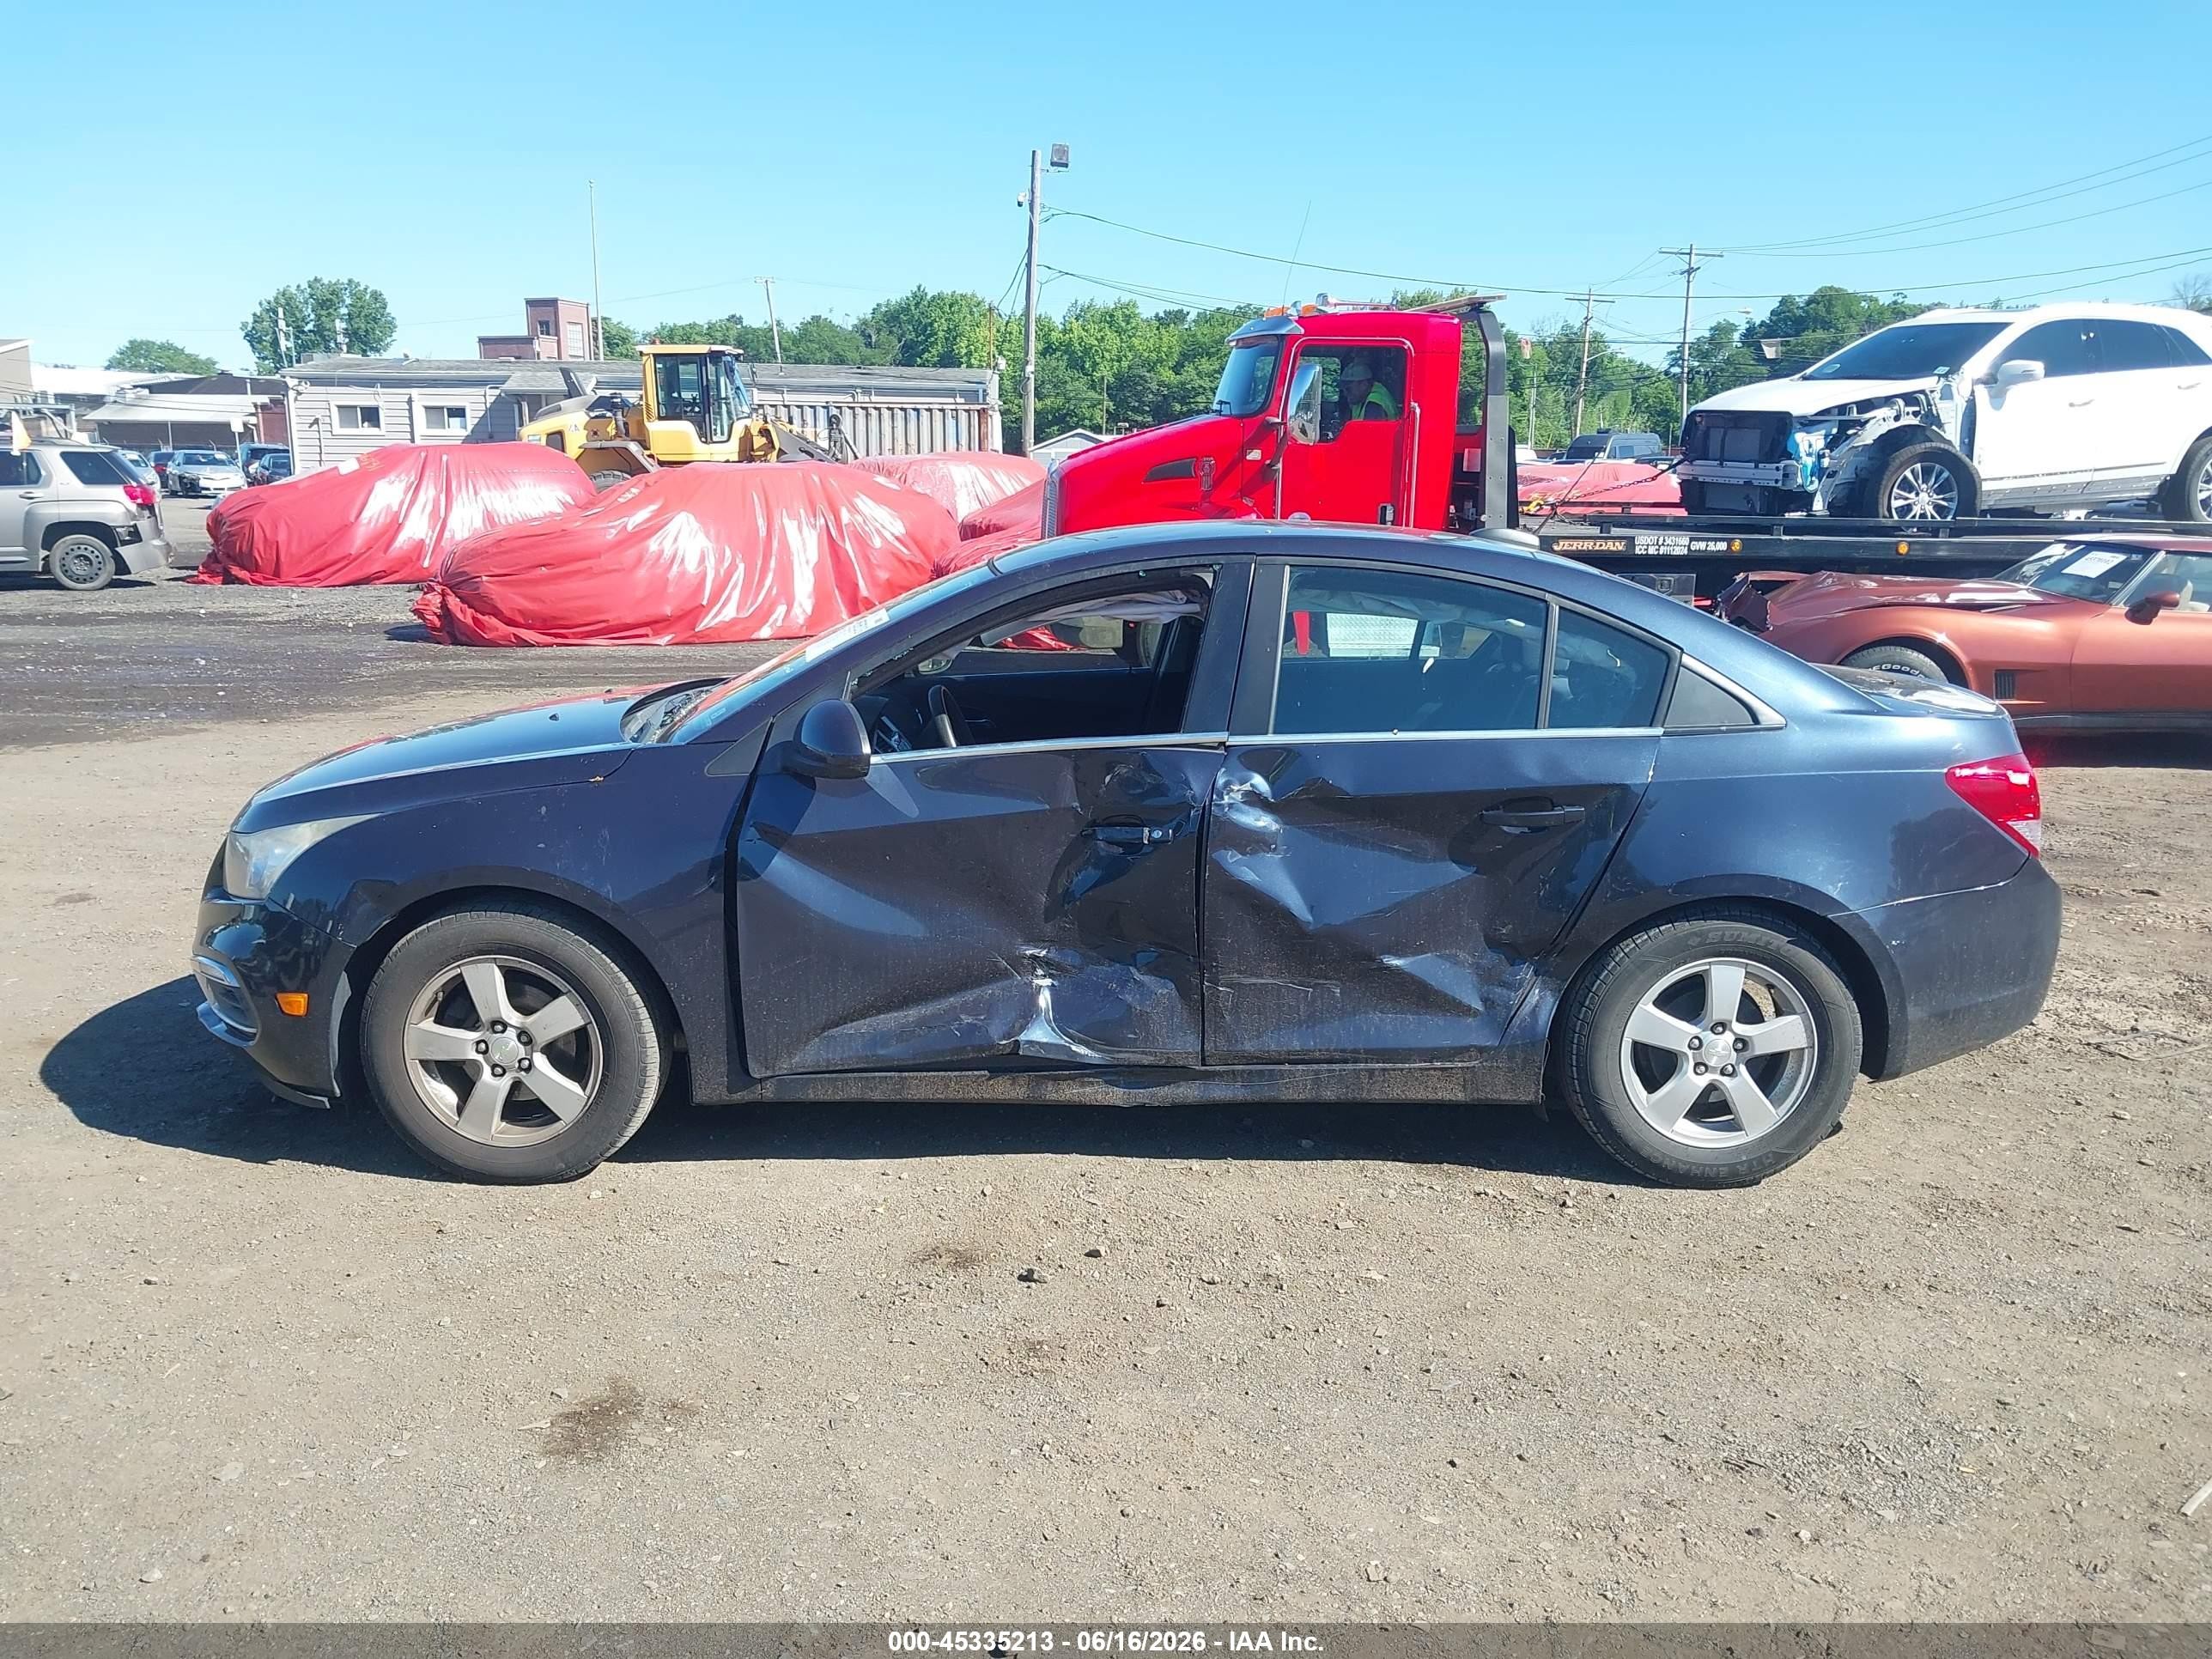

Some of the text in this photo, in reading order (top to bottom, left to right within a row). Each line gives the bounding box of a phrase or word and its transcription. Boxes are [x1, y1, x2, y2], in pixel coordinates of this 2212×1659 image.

[1635, 536, 1658, 545] USDOT
[1658, 536, 1663, 545] #
[1635, 545, 1647, 555] ICC
[1648, 545, 1659, 555] MC
[1690, 541, 1728, 552] GVW 26,000
